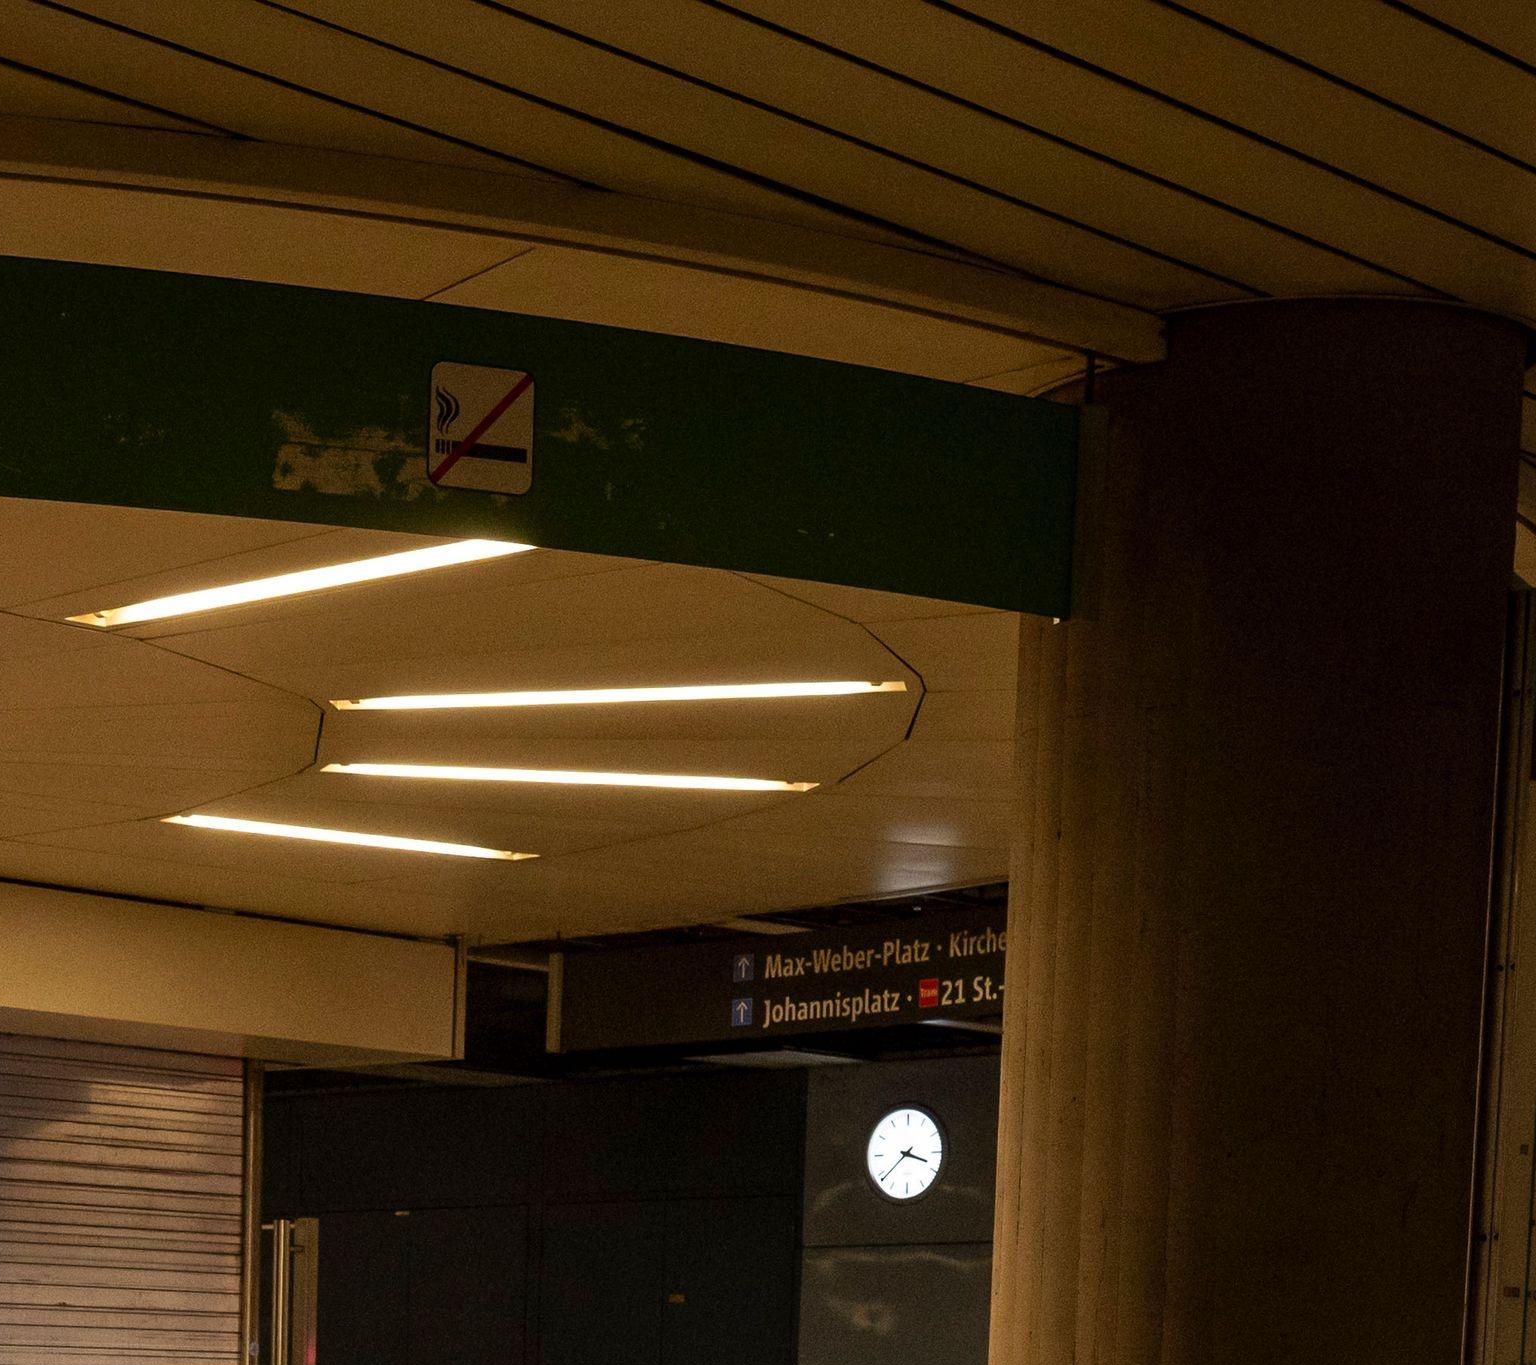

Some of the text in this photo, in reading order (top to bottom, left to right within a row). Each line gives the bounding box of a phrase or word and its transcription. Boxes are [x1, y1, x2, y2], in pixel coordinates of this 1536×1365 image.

[763, 938, 930, 979] Max-Weber-Platz
[762, 988, 901, 1028] Johannisplatz
[940, 979, 966, 1006] 21
